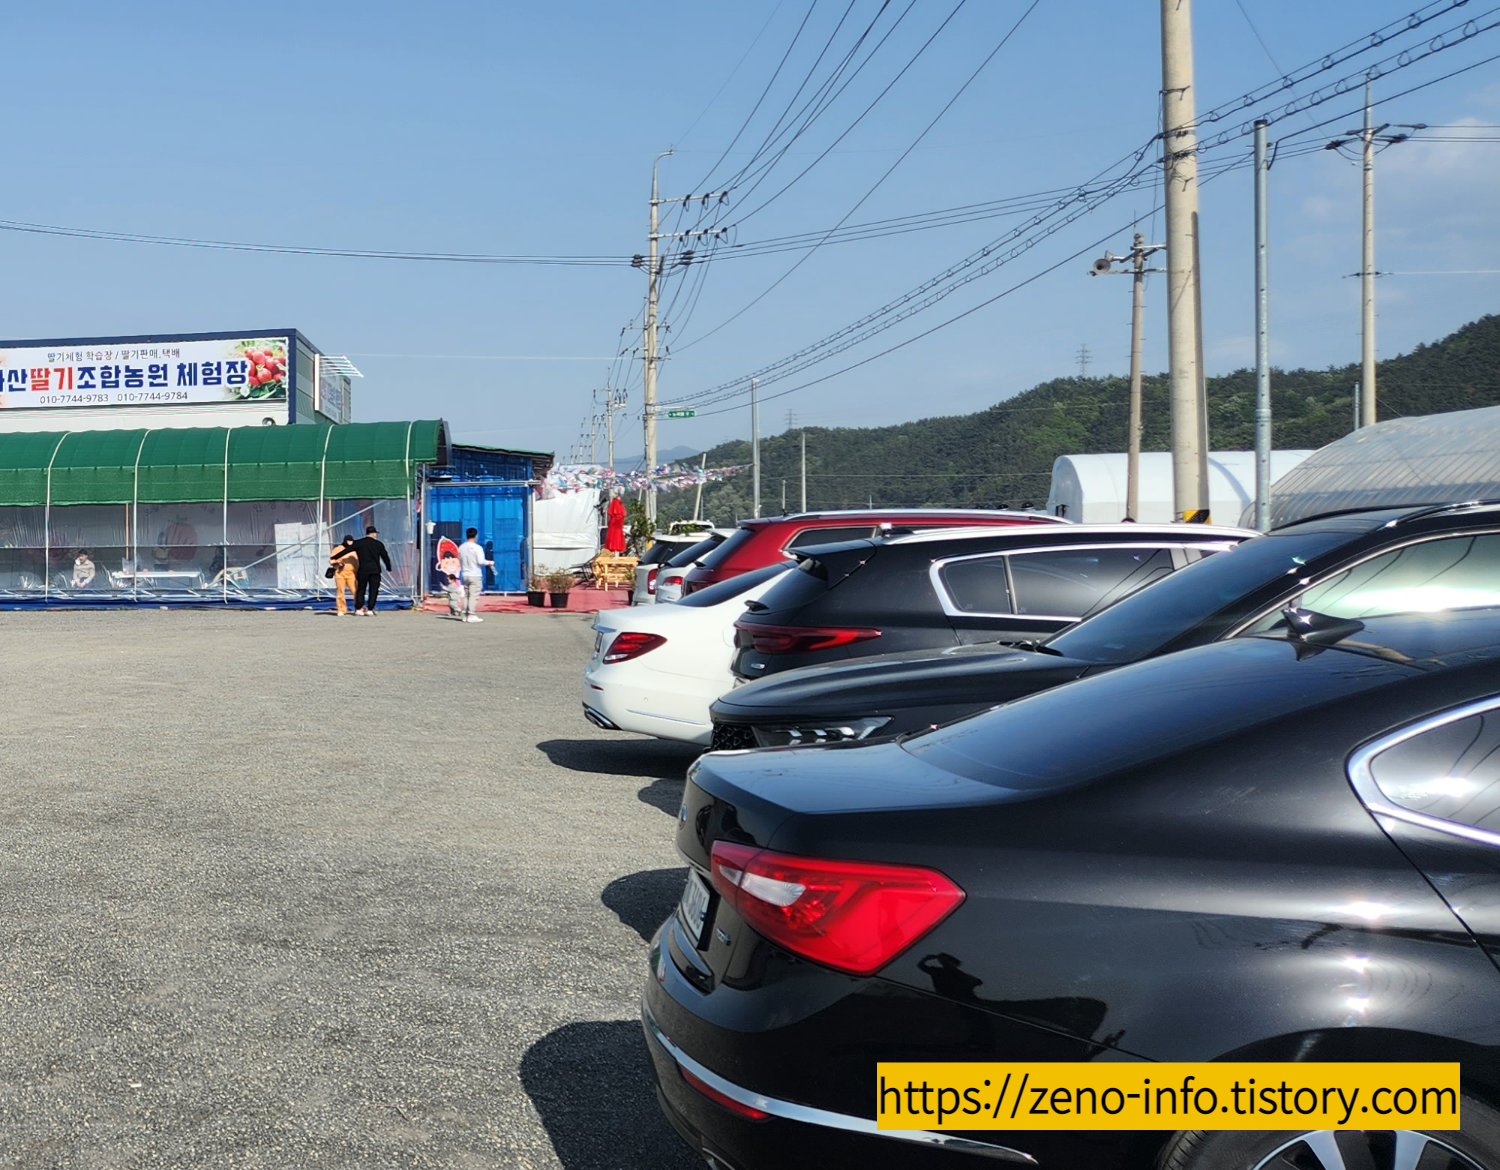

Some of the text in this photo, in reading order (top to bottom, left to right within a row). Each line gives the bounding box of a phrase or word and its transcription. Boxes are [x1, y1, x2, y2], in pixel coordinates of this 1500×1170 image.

[48, 351, 83, 363] 딸기체험
[86, 350, 113, 362] 학습장
[176, 360, 248, 387] 체험장
[40, 391, 188, 404] 010-7744-9783 010-7744-9784
